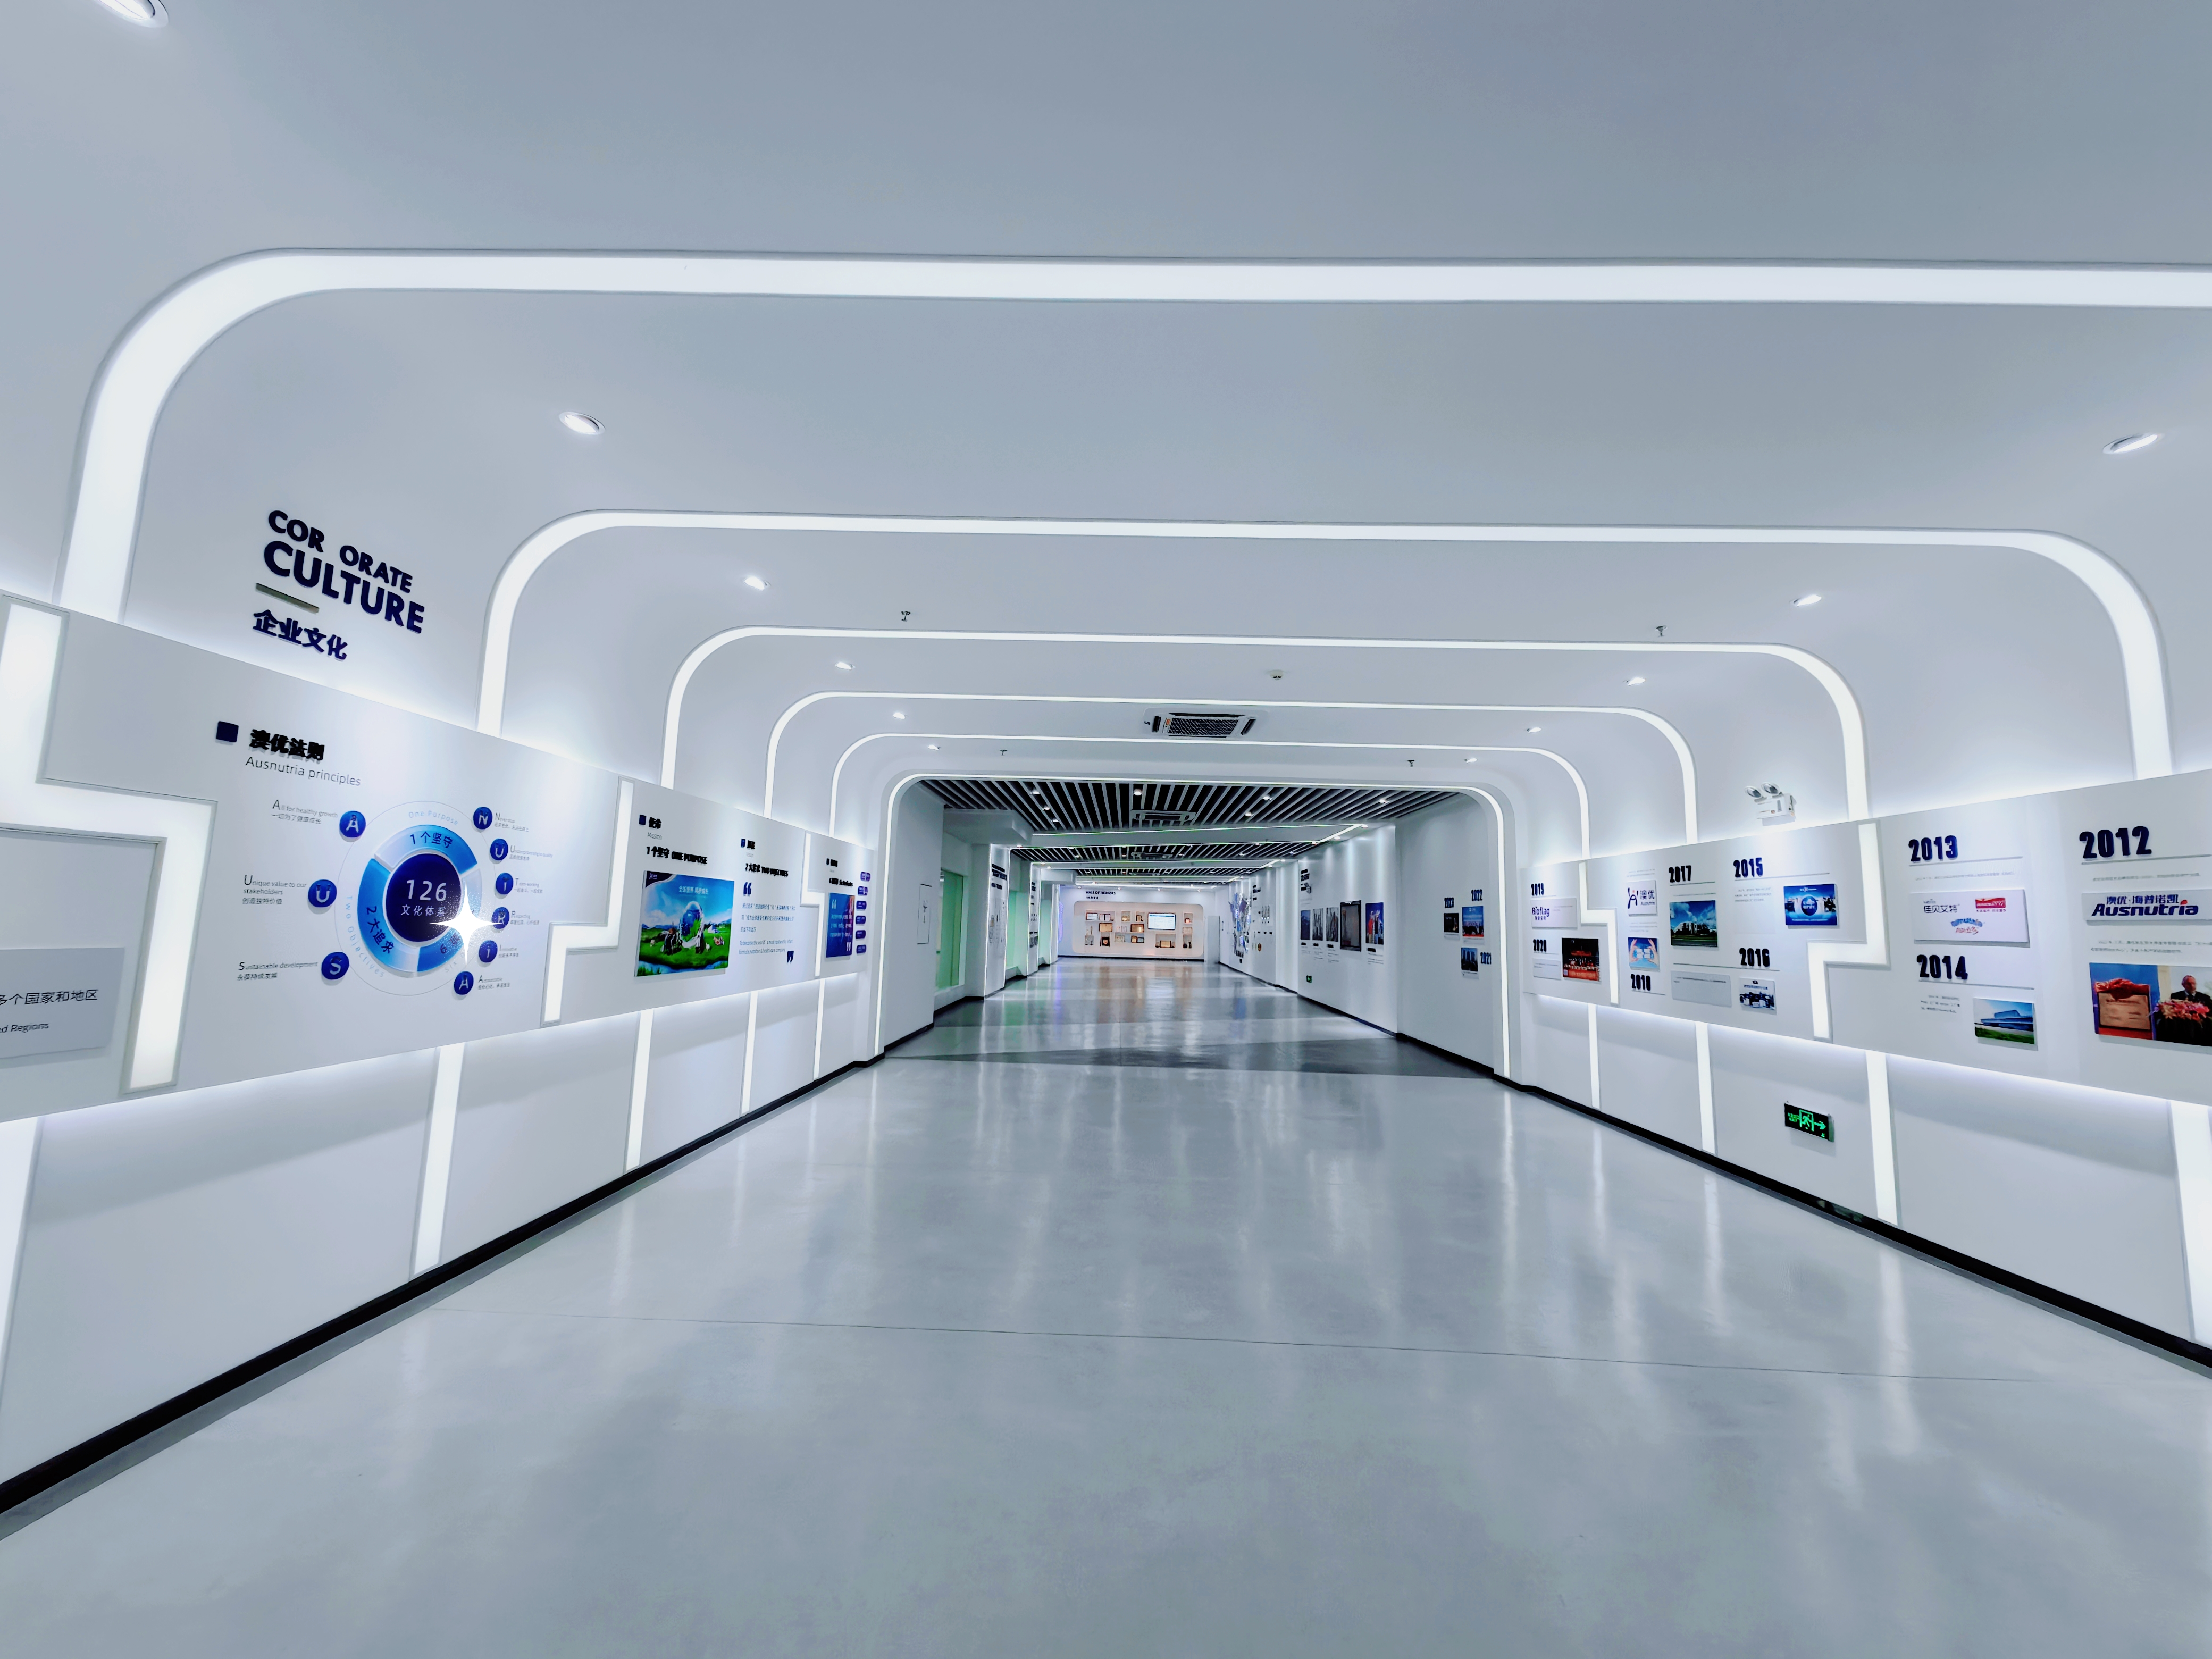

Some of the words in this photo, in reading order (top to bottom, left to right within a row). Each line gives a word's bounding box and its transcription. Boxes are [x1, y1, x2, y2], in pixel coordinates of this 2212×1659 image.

[264, 541, 425, 634] CULTURE
[253, 609, 348, 660] 企业文化
[249, 728, 325, 761] 澳优法则
[245, 757, 305, 776] Ausnutria
[308, 769, 361, 786] principles
[428, 810, 458, 826] Purpose
[409, 831, 453, 849] 1个坚守
[1908, 835, 1958, 862] 2013
[2079, 826, 2152, 859] 2012
[1668, 865, 1692, 883] 2017
[1733, 857, 1764, 878] 2015
[406, 879, 447, 902] 126
[1471, 889, 1483, 902] 2022
[1532, 906, 1549, 917] Bioflag
[2091, 899, 2199, 917] Ausnutria
[366, 906, 395, 954] 2大追求
[1480, 952, 1492, 965] 2021
[1739, 948, 1771, 967] 2016
[1916, 954, 1968, 980] 2014
